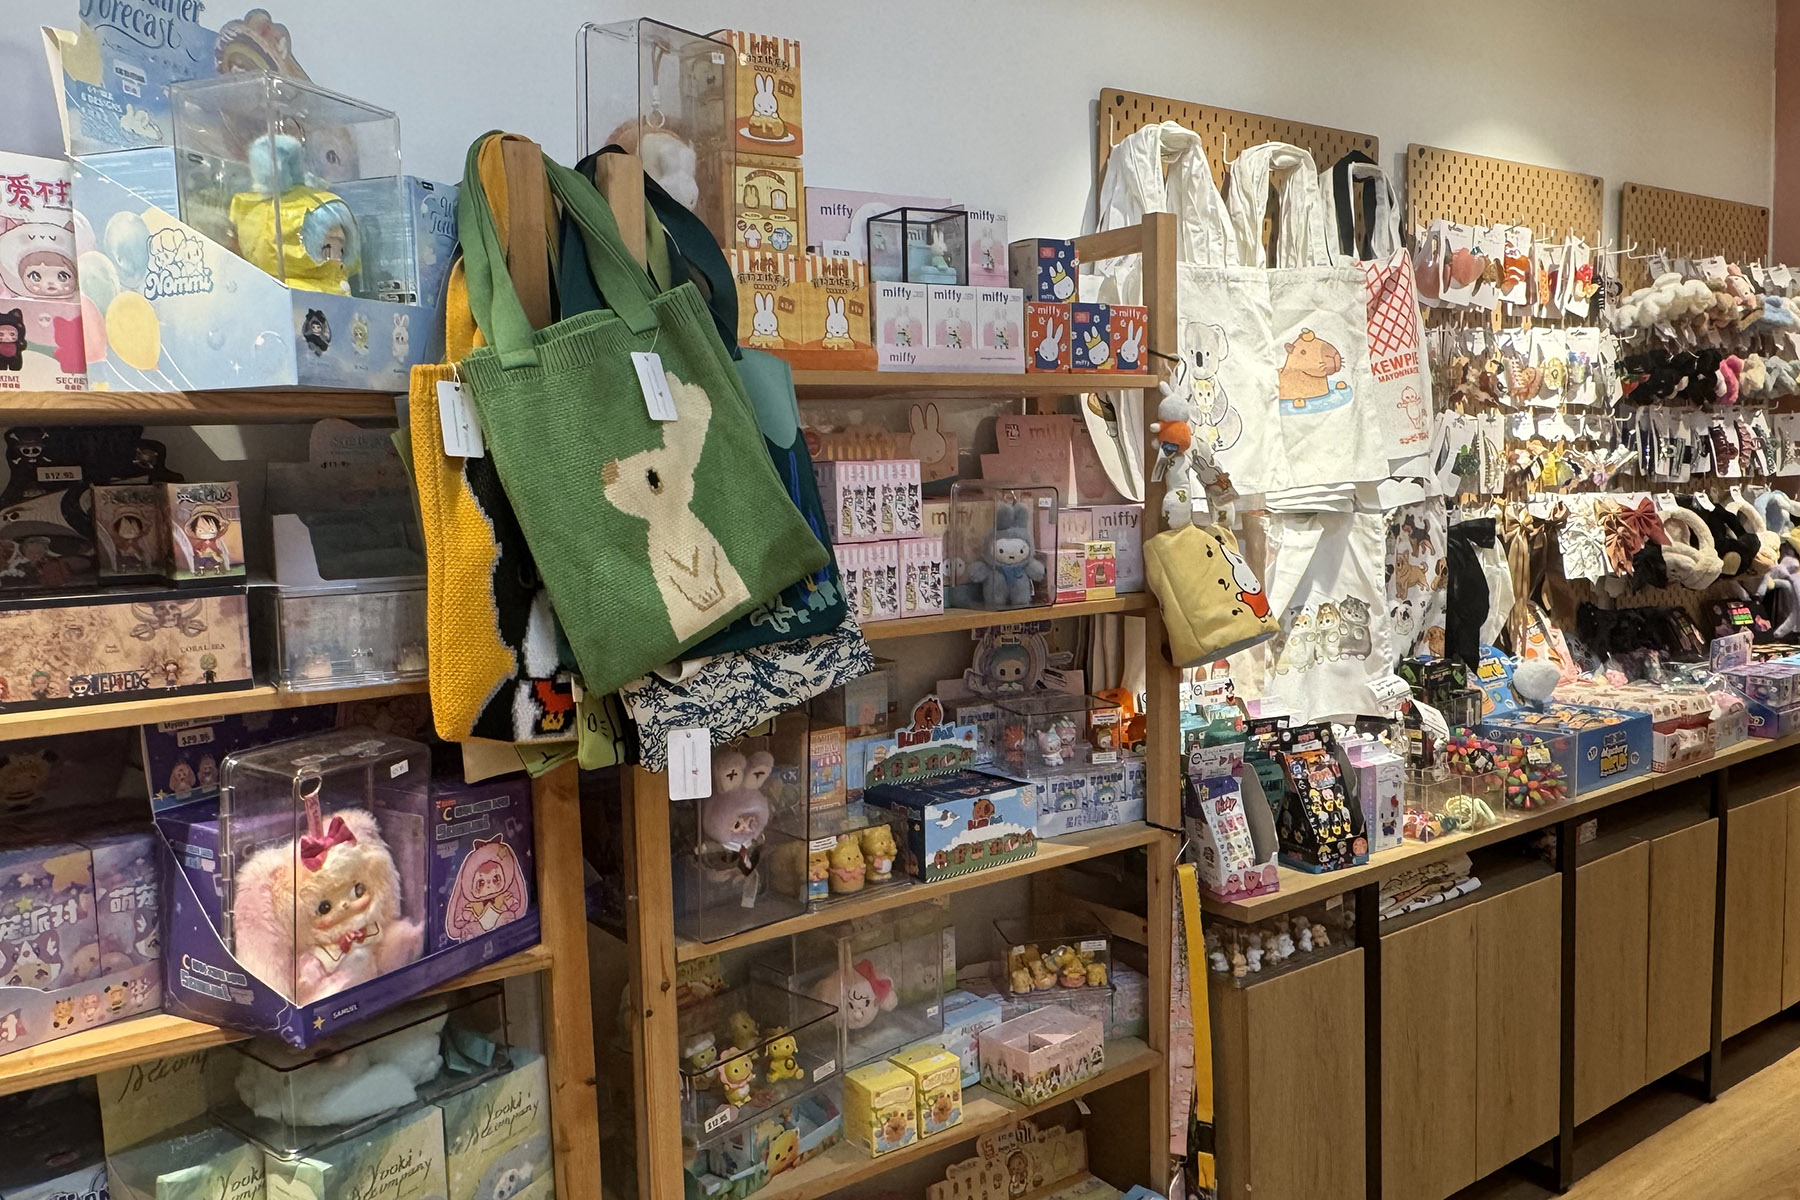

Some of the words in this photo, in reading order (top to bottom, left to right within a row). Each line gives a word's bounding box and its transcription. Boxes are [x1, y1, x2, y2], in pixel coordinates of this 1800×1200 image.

[820, 204, 853, 218] miffy
[969, 210, 996, 223] miffy
[883, 286, 912, 300] miffy
[934, 289, 962, 302] miffy
[982, 291, 1009, 304] miffy
[1037, 305, 1061, 317] miffy
[1119, 308, 1141, 320] miffy
[889, 351, 916, 364] miffy
[1371, 352, 1419, 376] KEWPIE
